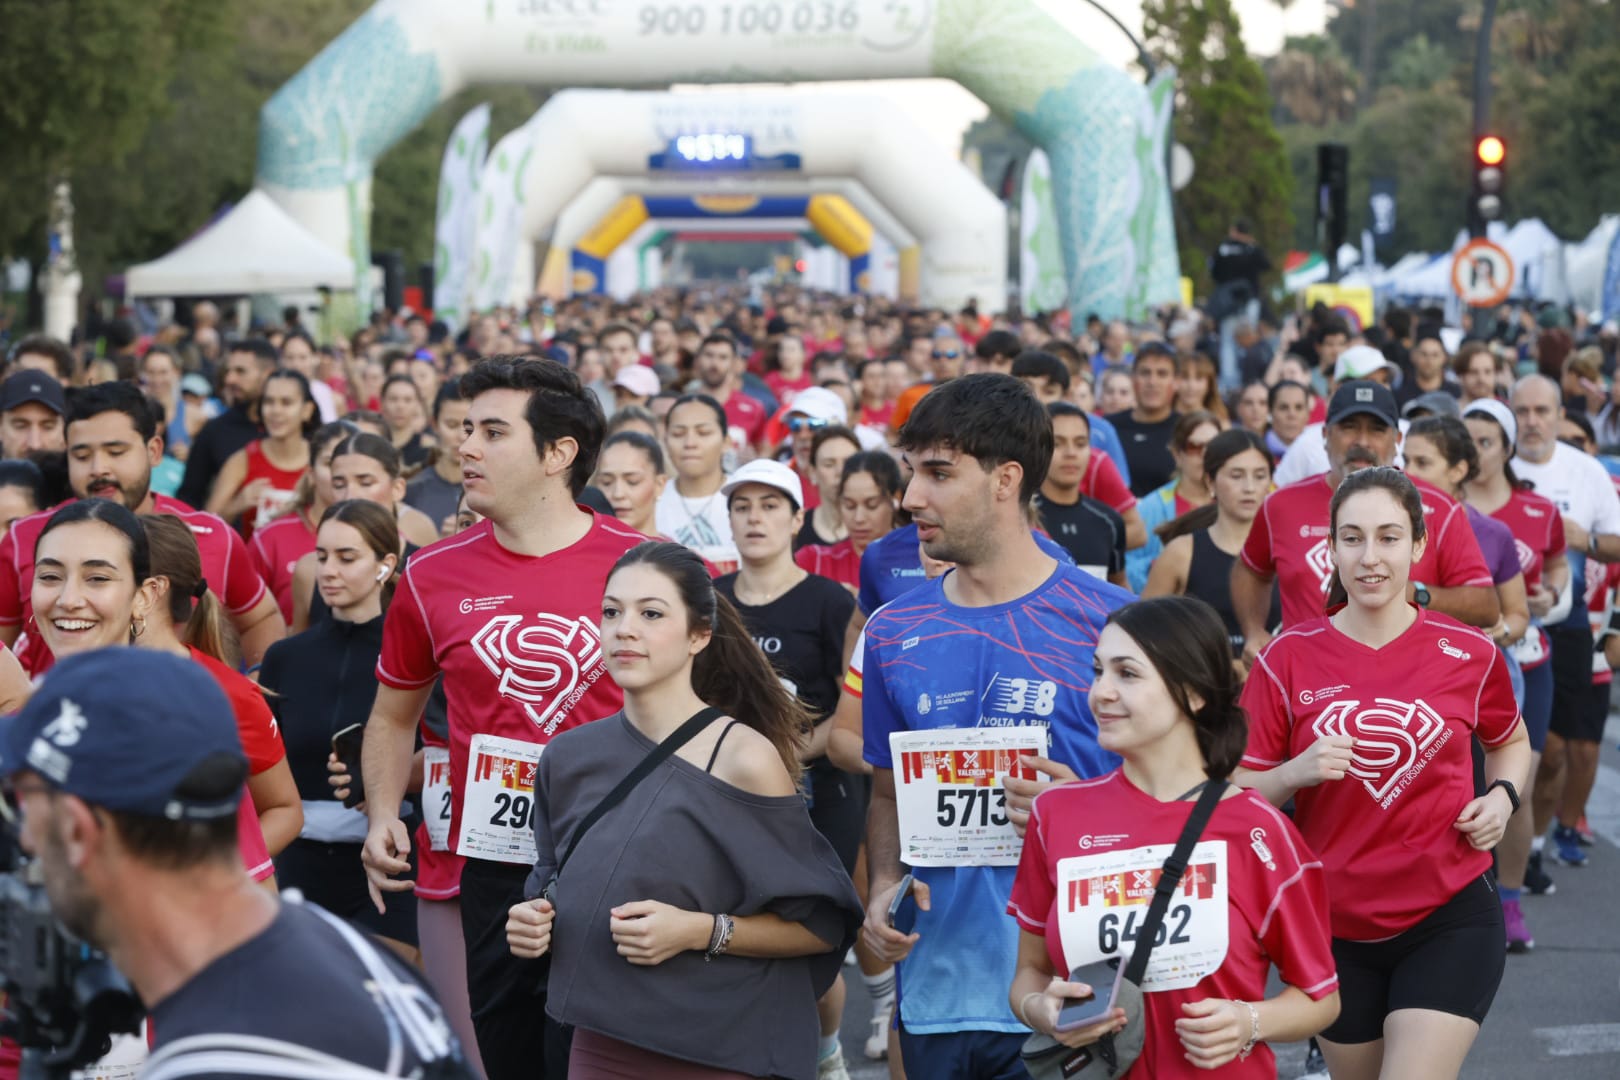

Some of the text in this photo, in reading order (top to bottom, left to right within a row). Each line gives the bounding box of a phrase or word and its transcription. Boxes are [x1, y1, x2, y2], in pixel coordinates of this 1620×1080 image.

[638, 0, 859, 36] 900 100 036
[561, 680, 591, 713] PERSONA
[1005, 677, 1057, 716] 38
[983, 716, 1015, 728] VOLTA
[957, 768, 986, 777] VALENCIA
[1399, 758, 1428, 789] PERSONA
[1424, 727, 1454, 760] SOLIDARIA
[937, 788, 1010, 827] 5713
